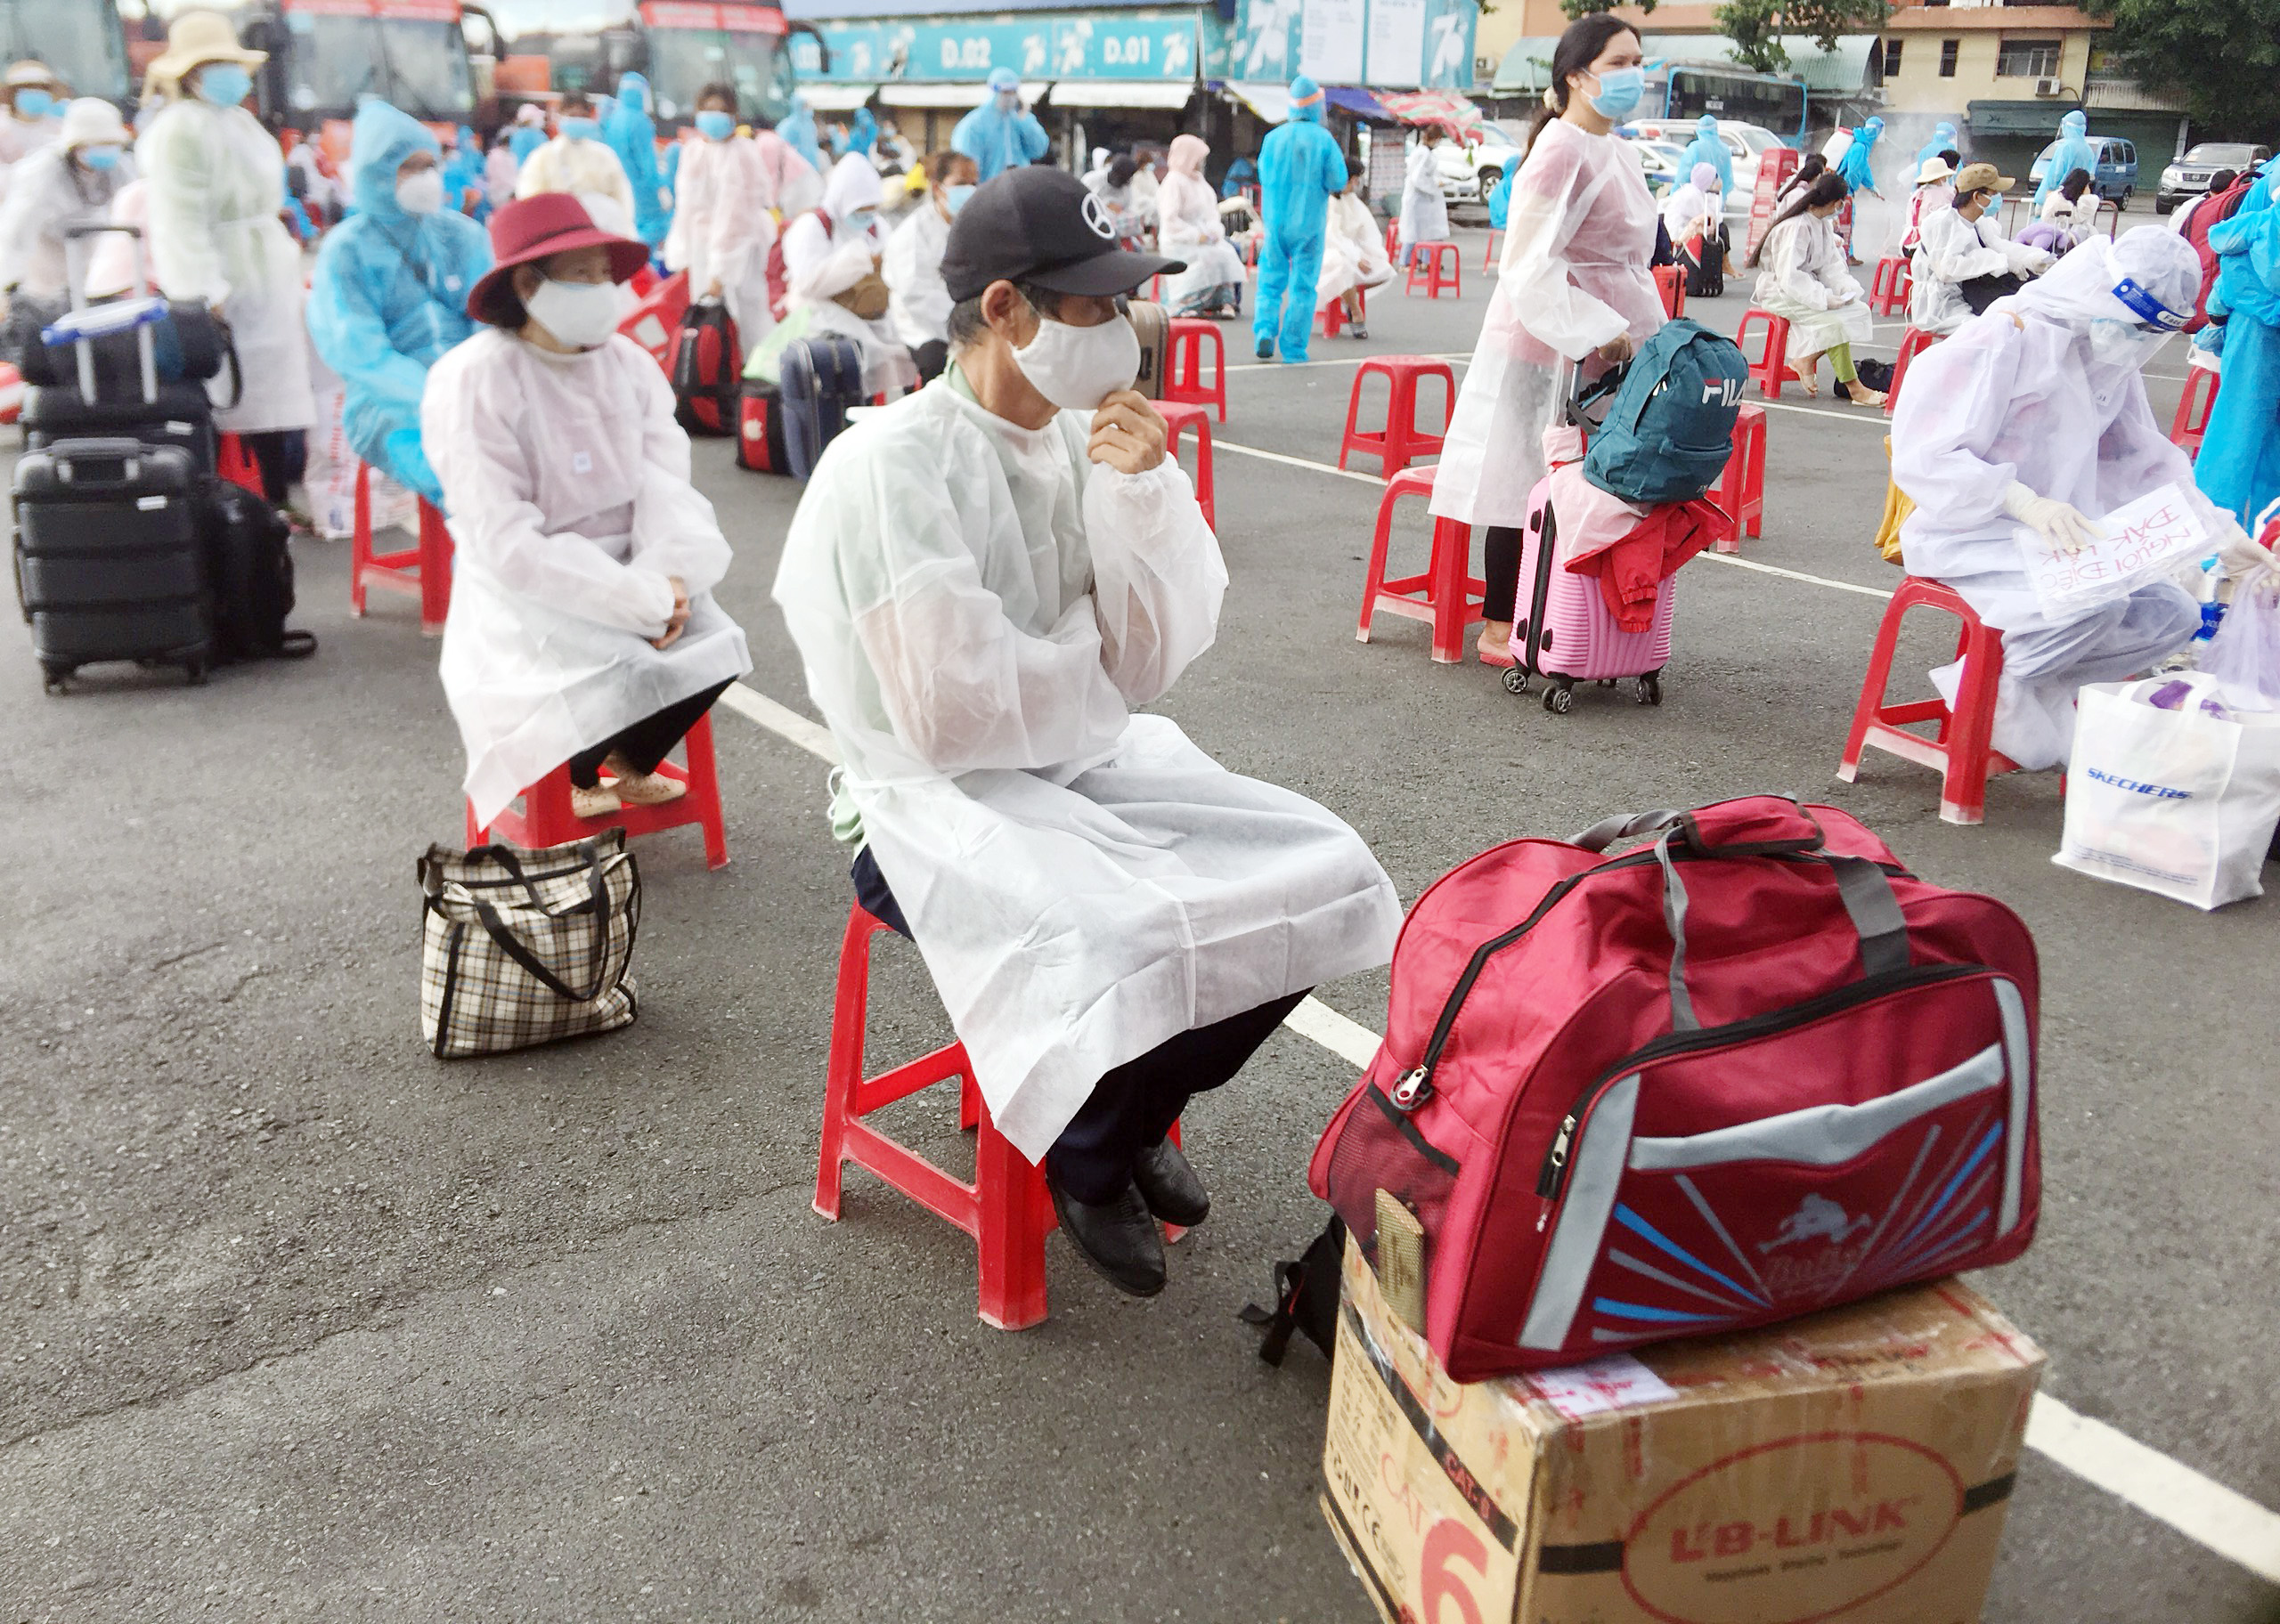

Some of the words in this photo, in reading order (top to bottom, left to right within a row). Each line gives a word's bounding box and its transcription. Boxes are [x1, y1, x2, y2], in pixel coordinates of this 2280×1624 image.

[940, 37, 991, 69] D.02
[1103, 36, 1150, 64] D.01
[2088, 767, 2194, 800] SKECHERS
